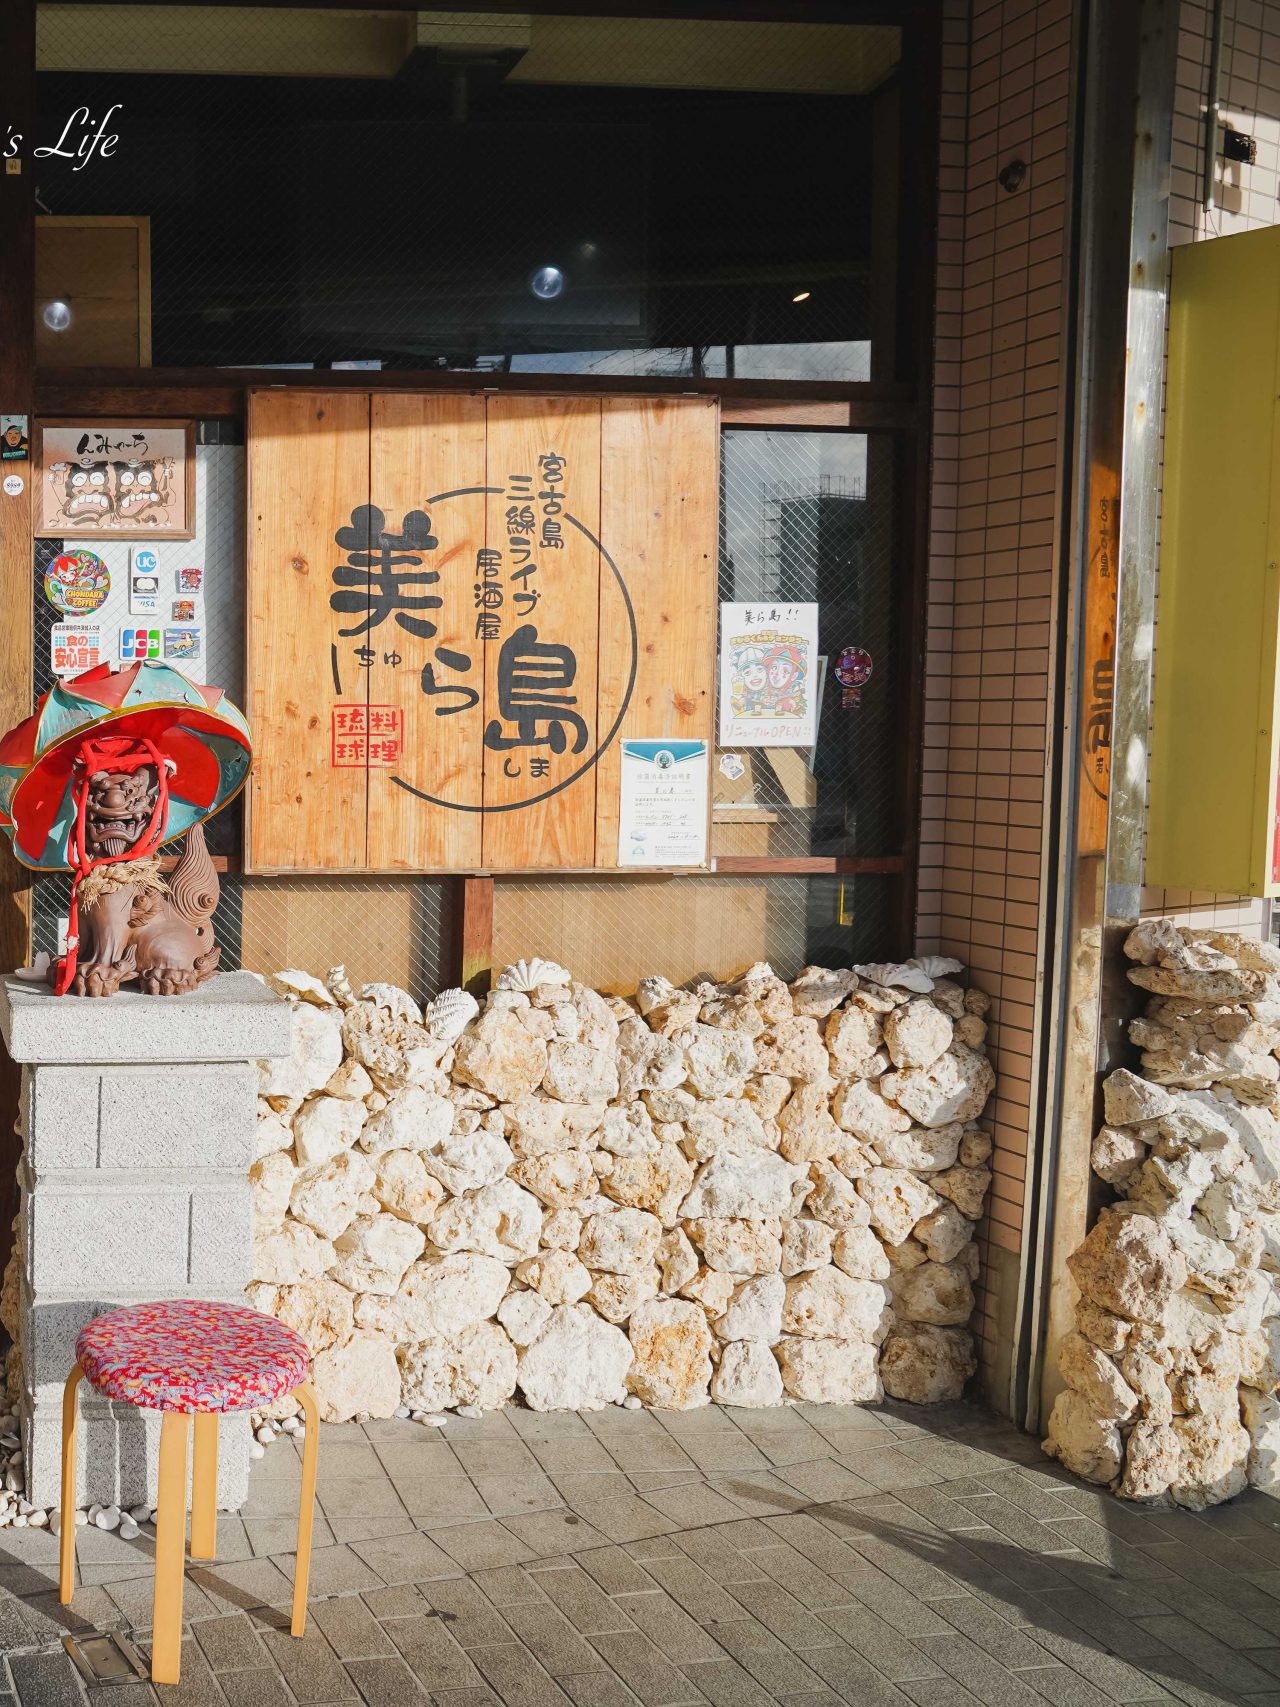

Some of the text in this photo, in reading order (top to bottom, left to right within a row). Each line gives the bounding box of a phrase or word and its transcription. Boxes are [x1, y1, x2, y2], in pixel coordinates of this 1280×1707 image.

[538, 451, 567, 549] 宮古島
[505, 475, 542, 617] 三線ライブ
[136, 556, 157, 568] UC
[66, 589, 104, 599] CHONDARA
[71, 599, 97, 607] COFFEE
[473, 548, 504, 641] 居酒屋
[66, 635, 89, 647] 食の
[54, 647, 100, 669] 安心宣言
[353, 644, 402, 668] ちゅ
[503, 757, 550, 778] しま
